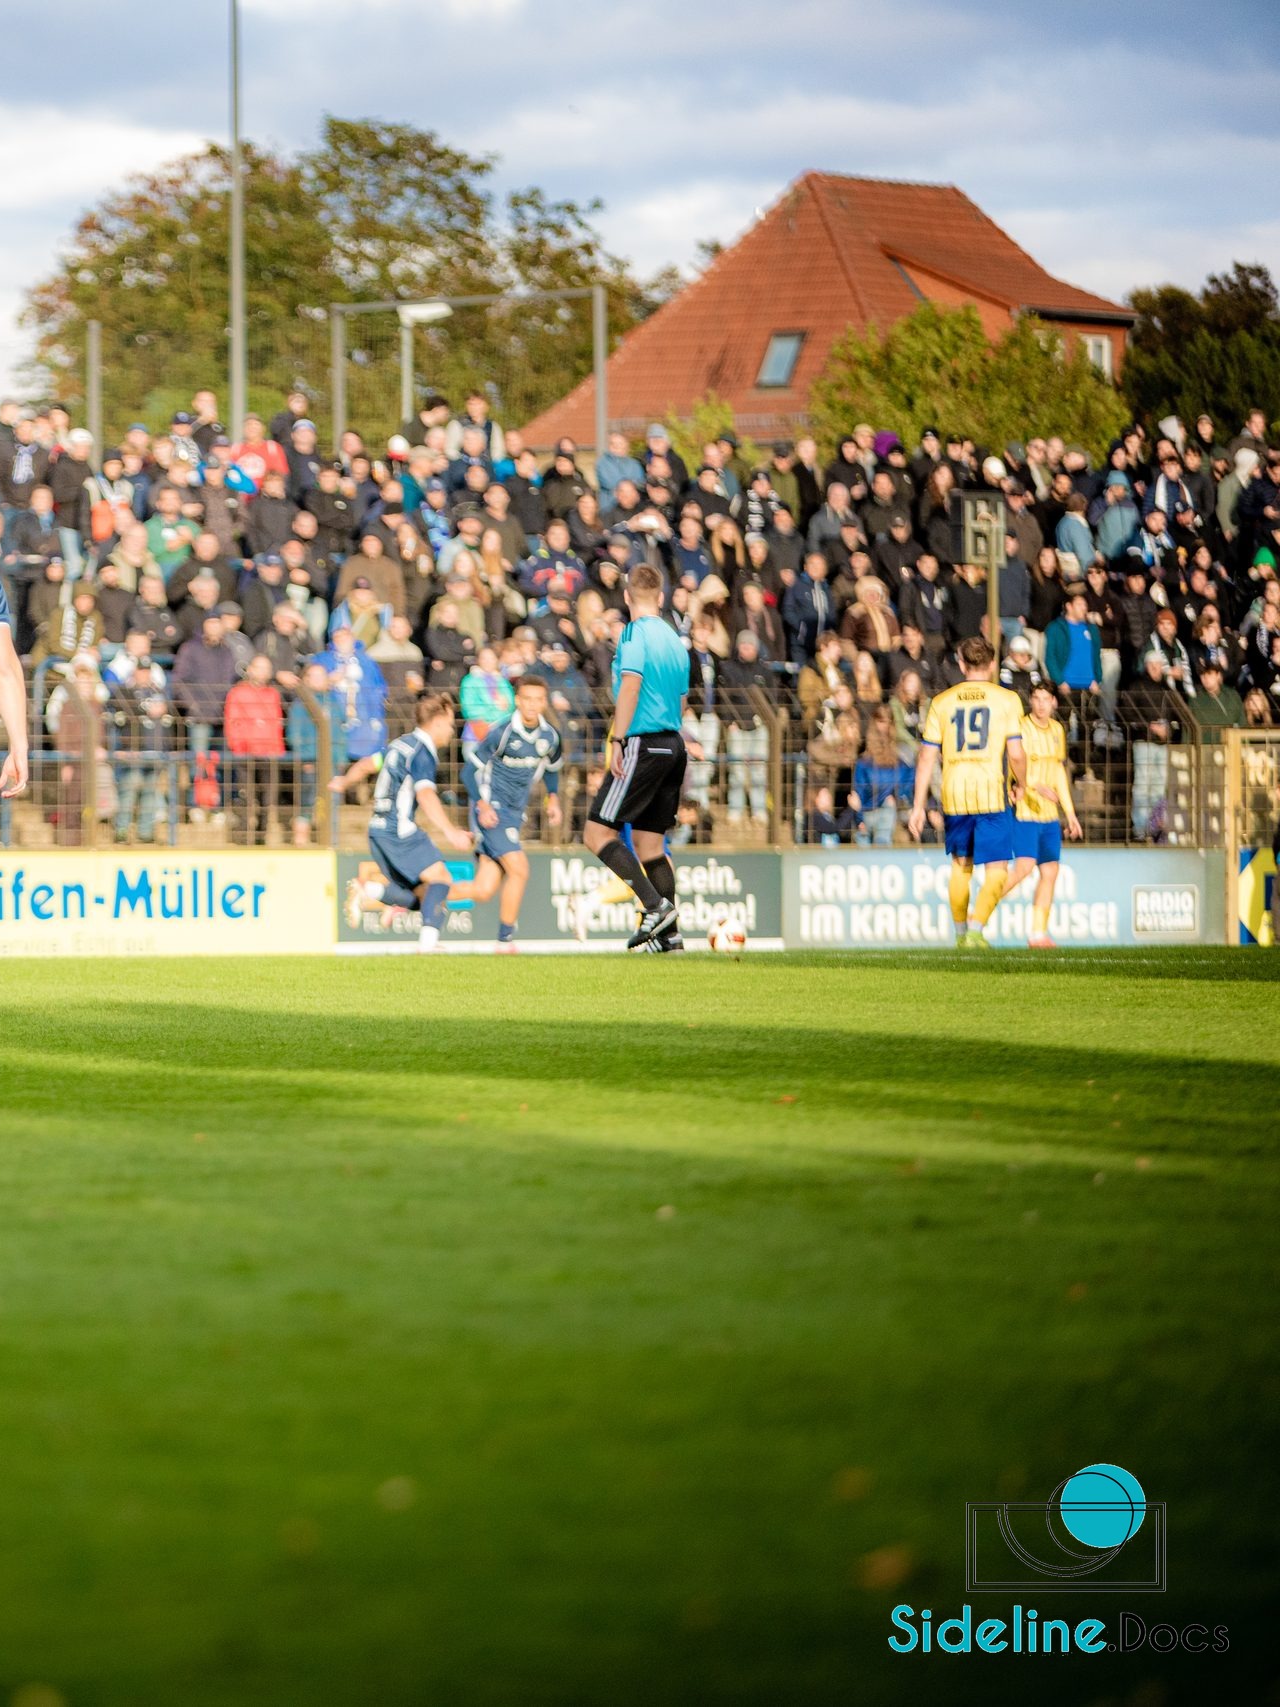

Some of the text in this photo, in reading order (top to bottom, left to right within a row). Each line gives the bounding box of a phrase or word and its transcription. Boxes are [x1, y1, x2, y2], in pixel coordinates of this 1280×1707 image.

[951, 705, 991, 752] 19
[799, 864, 905, 902] RADIO
[1136, 891, 1195, 913] RADIO
[799, 904, 844, 942] IM
[850, 904, 950, 942] KARLI
